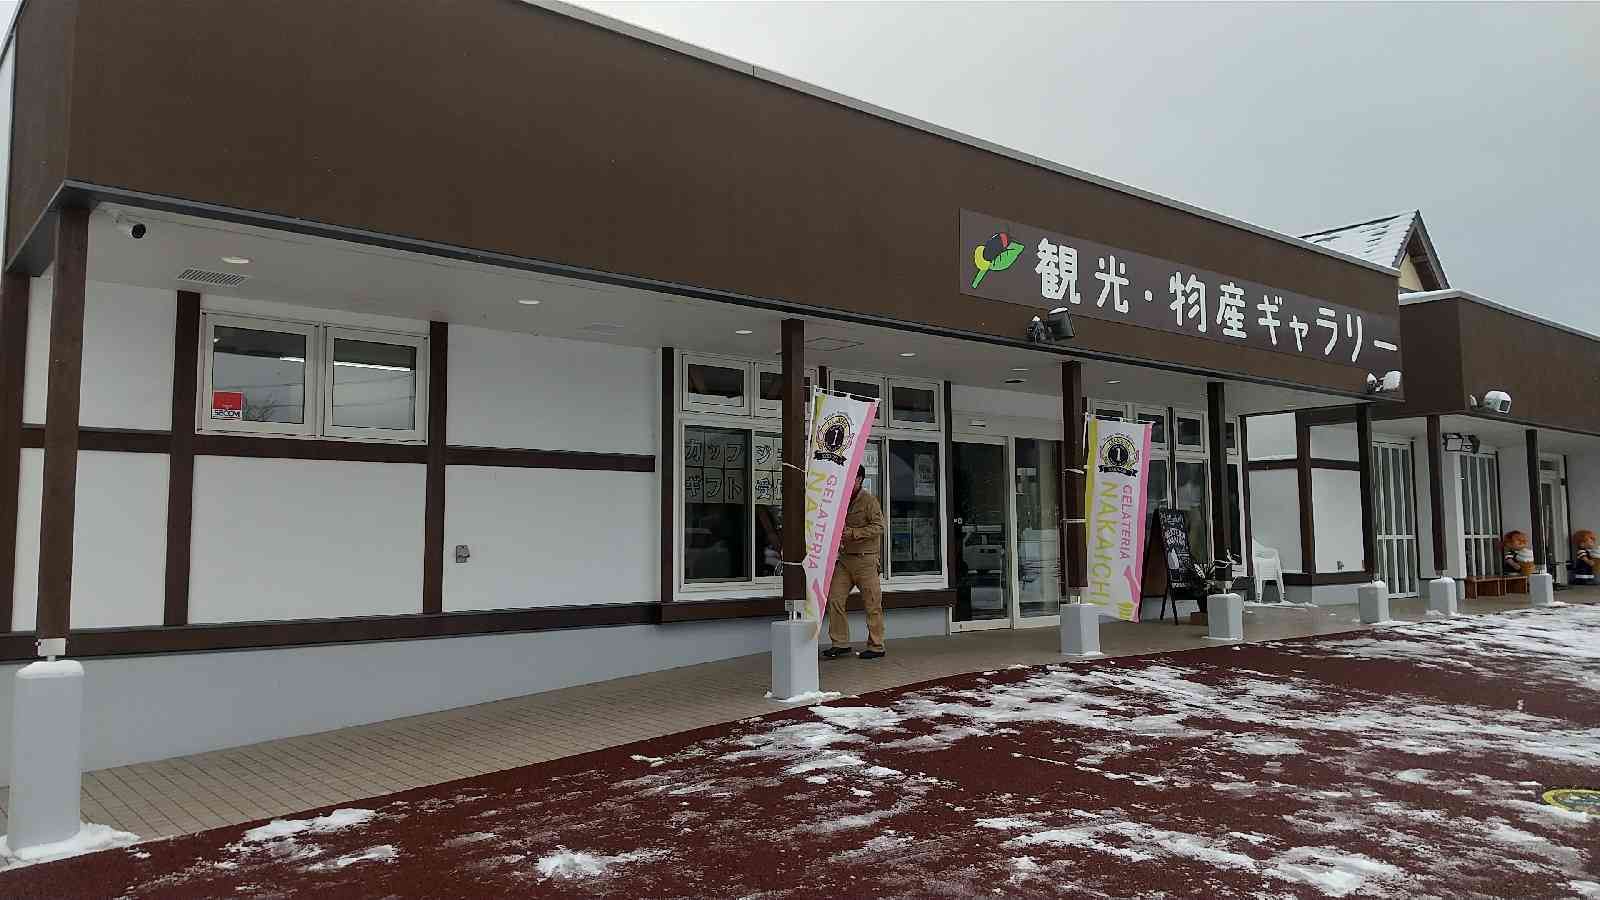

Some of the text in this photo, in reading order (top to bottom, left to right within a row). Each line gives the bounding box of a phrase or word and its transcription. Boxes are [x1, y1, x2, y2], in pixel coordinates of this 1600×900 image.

[1034, 237, 1398, 363] 観光・物産ギャラリー
[807, 473, 838, 570] GELATERIA
[1088, 480, 1121, 607] NAKAICHI
[1119, 484, 1133, 560] GELATERIA
